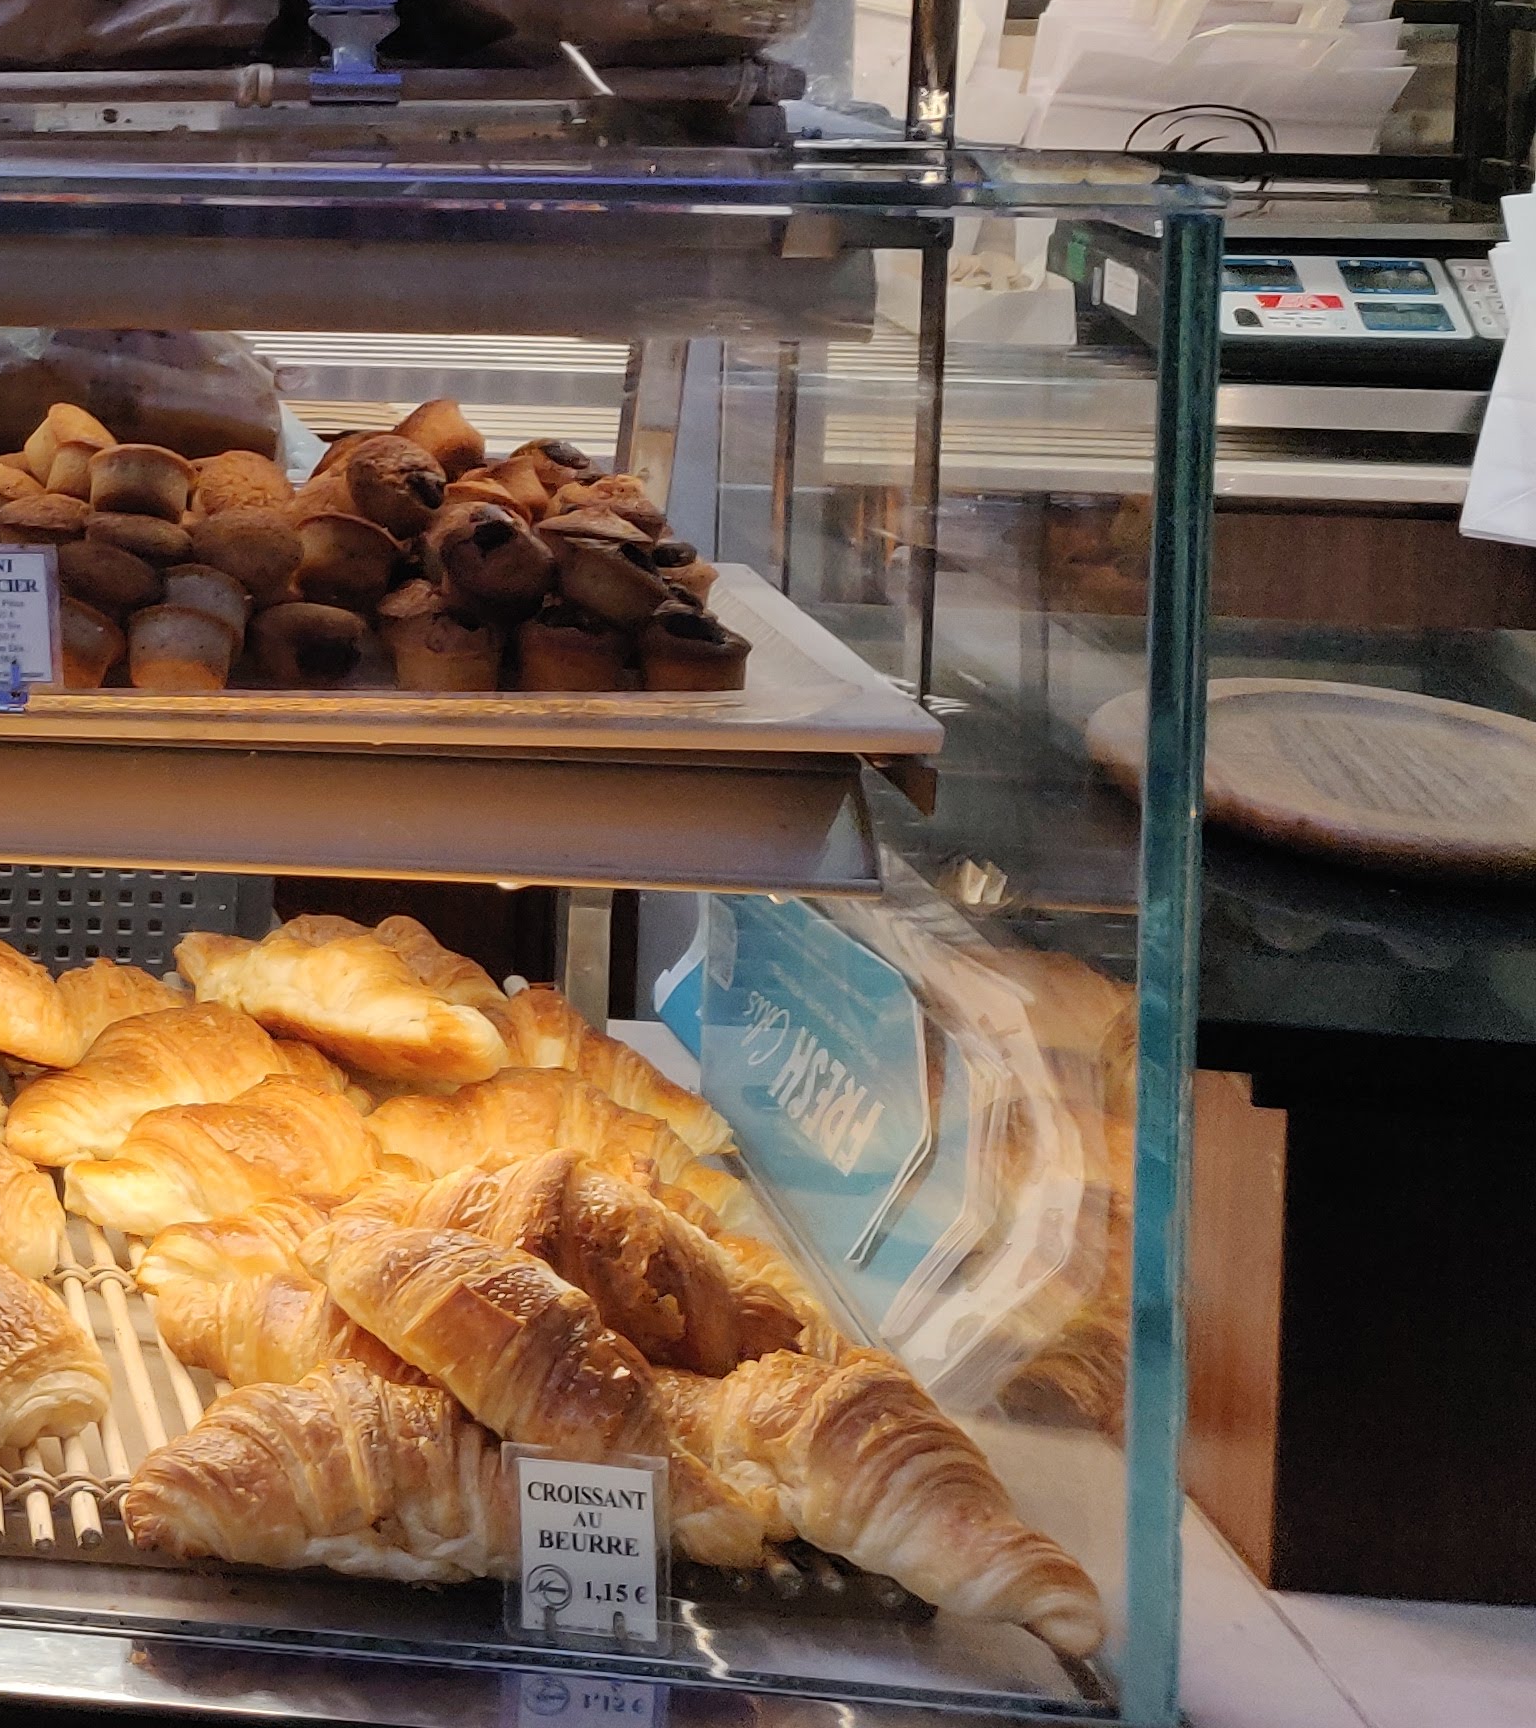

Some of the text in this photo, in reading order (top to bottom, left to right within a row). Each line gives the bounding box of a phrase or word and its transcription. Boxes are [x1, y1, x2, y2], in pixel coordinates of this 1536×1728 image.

[766, 1025, 886, 1177] FRESH
[527, 1480, 648, 1511] CROISSANT
[572, 1511, 603, 1529] AU
[538, 1529, 640, 1558] BEURRE
[583, 1580, 629, 1604] 1,15
[634, 1585, 648, 1605] €
